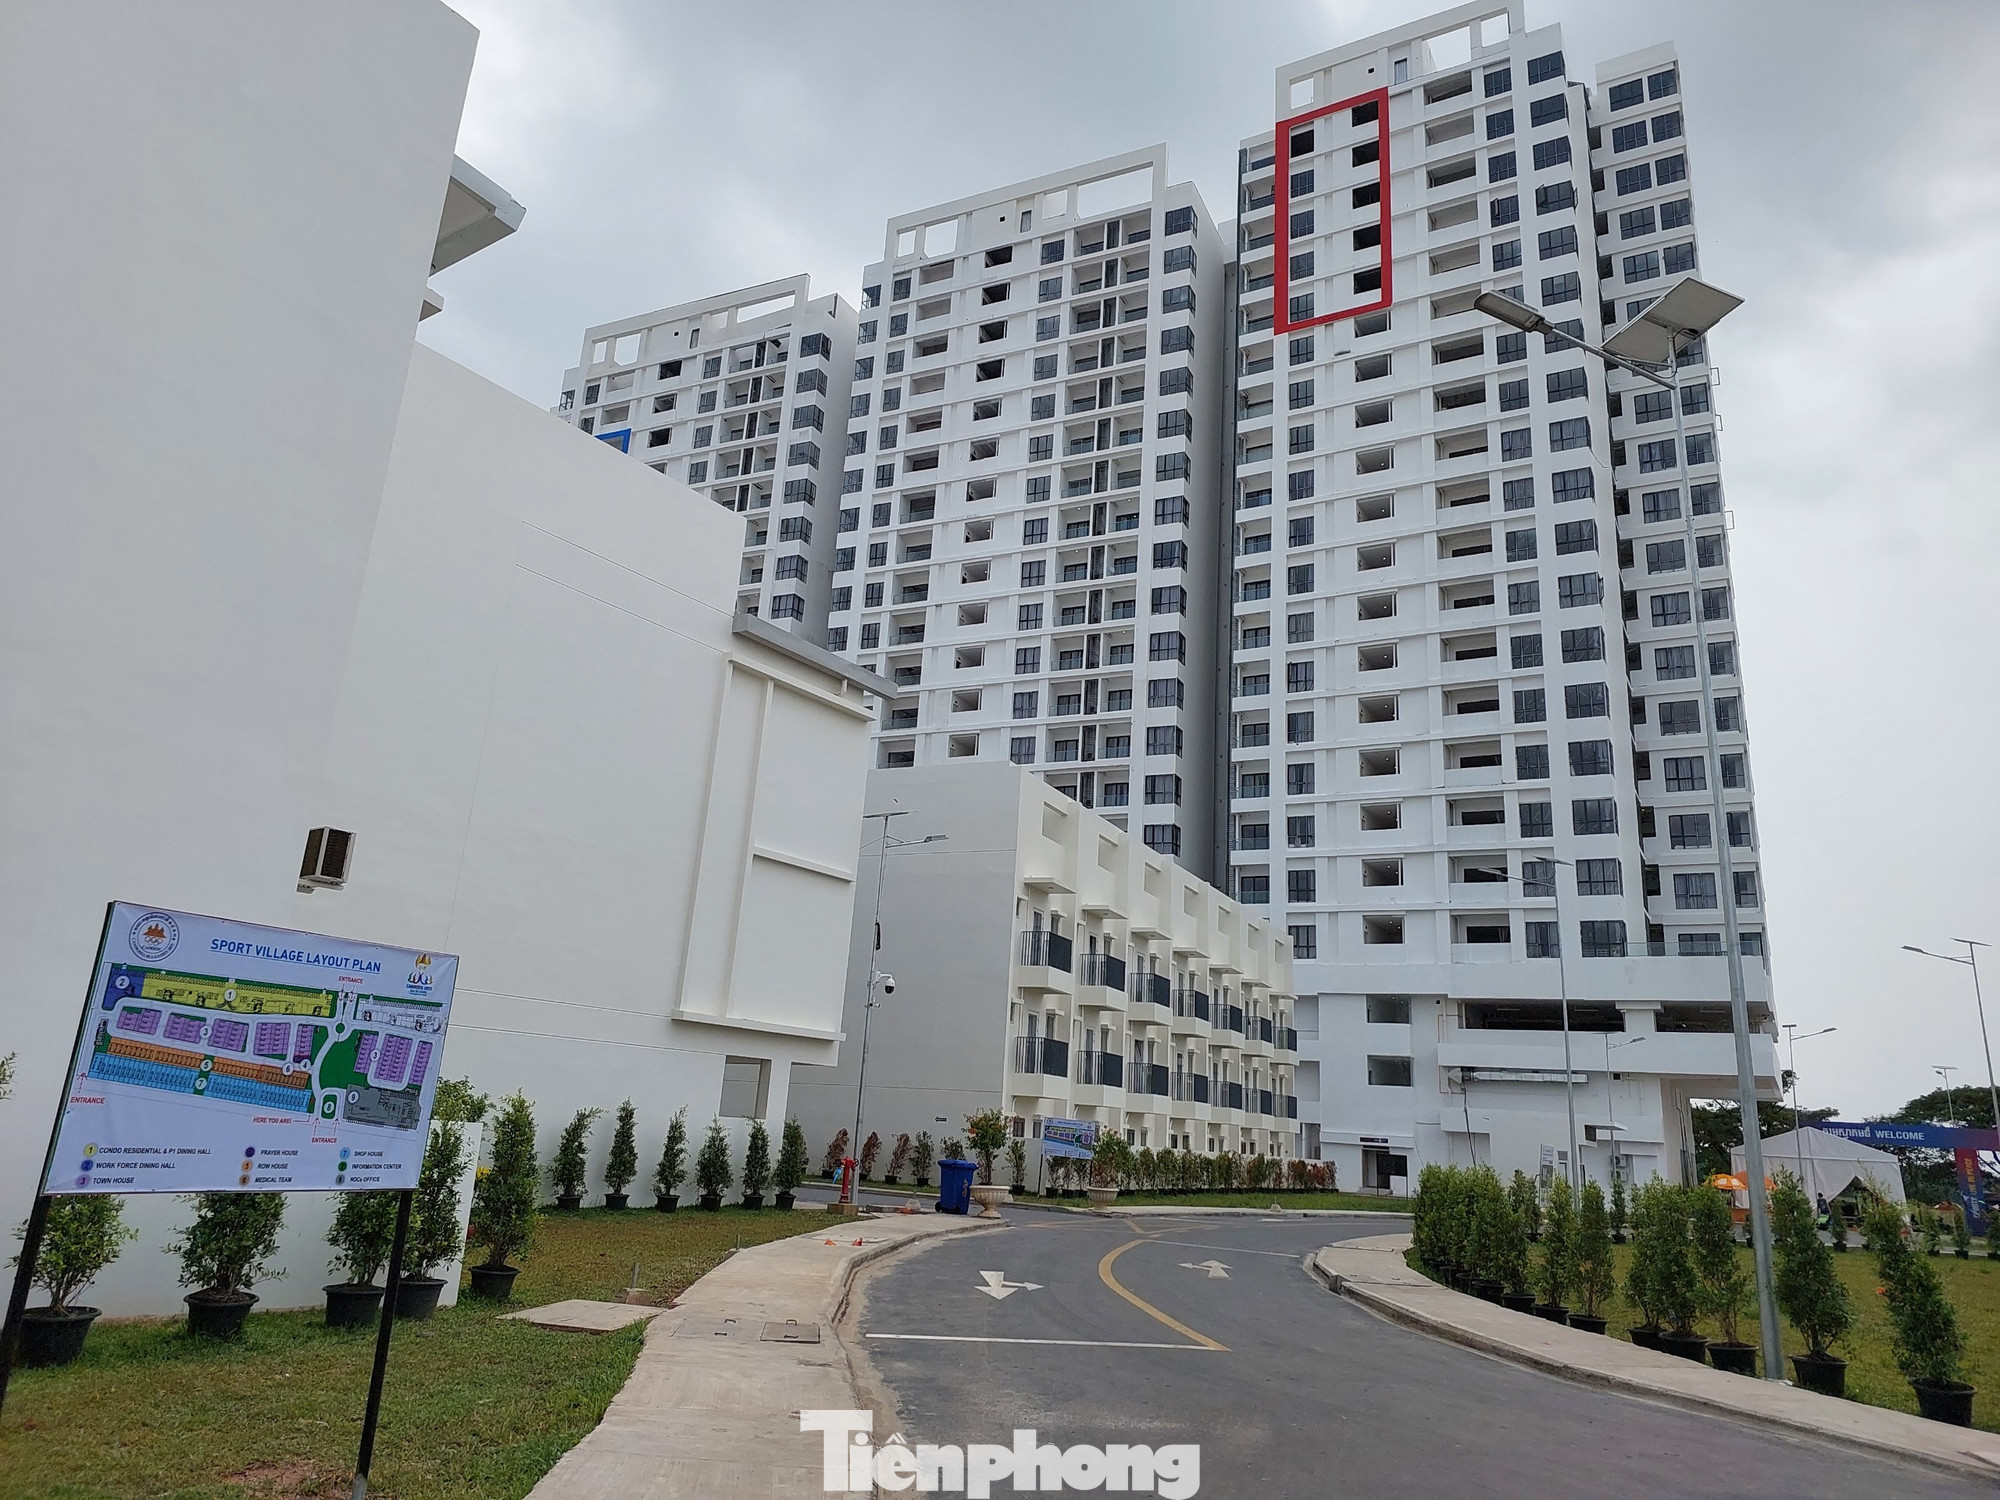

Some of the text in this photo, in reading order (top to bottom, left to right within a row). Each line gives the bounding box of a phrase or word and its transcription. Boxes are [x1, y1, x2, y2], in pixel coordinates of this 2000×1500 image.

[211, 938, 381, 972] SPORT VILLAGE LAYOUT PLAN
[338, 975, 364, 984] ENTRANCE
[70, 1096, 105, 1104] ENTRANCE
[253, 1116, 268, 1124] HERE
[1874, 1129, 1925, 1141] WELCOME
